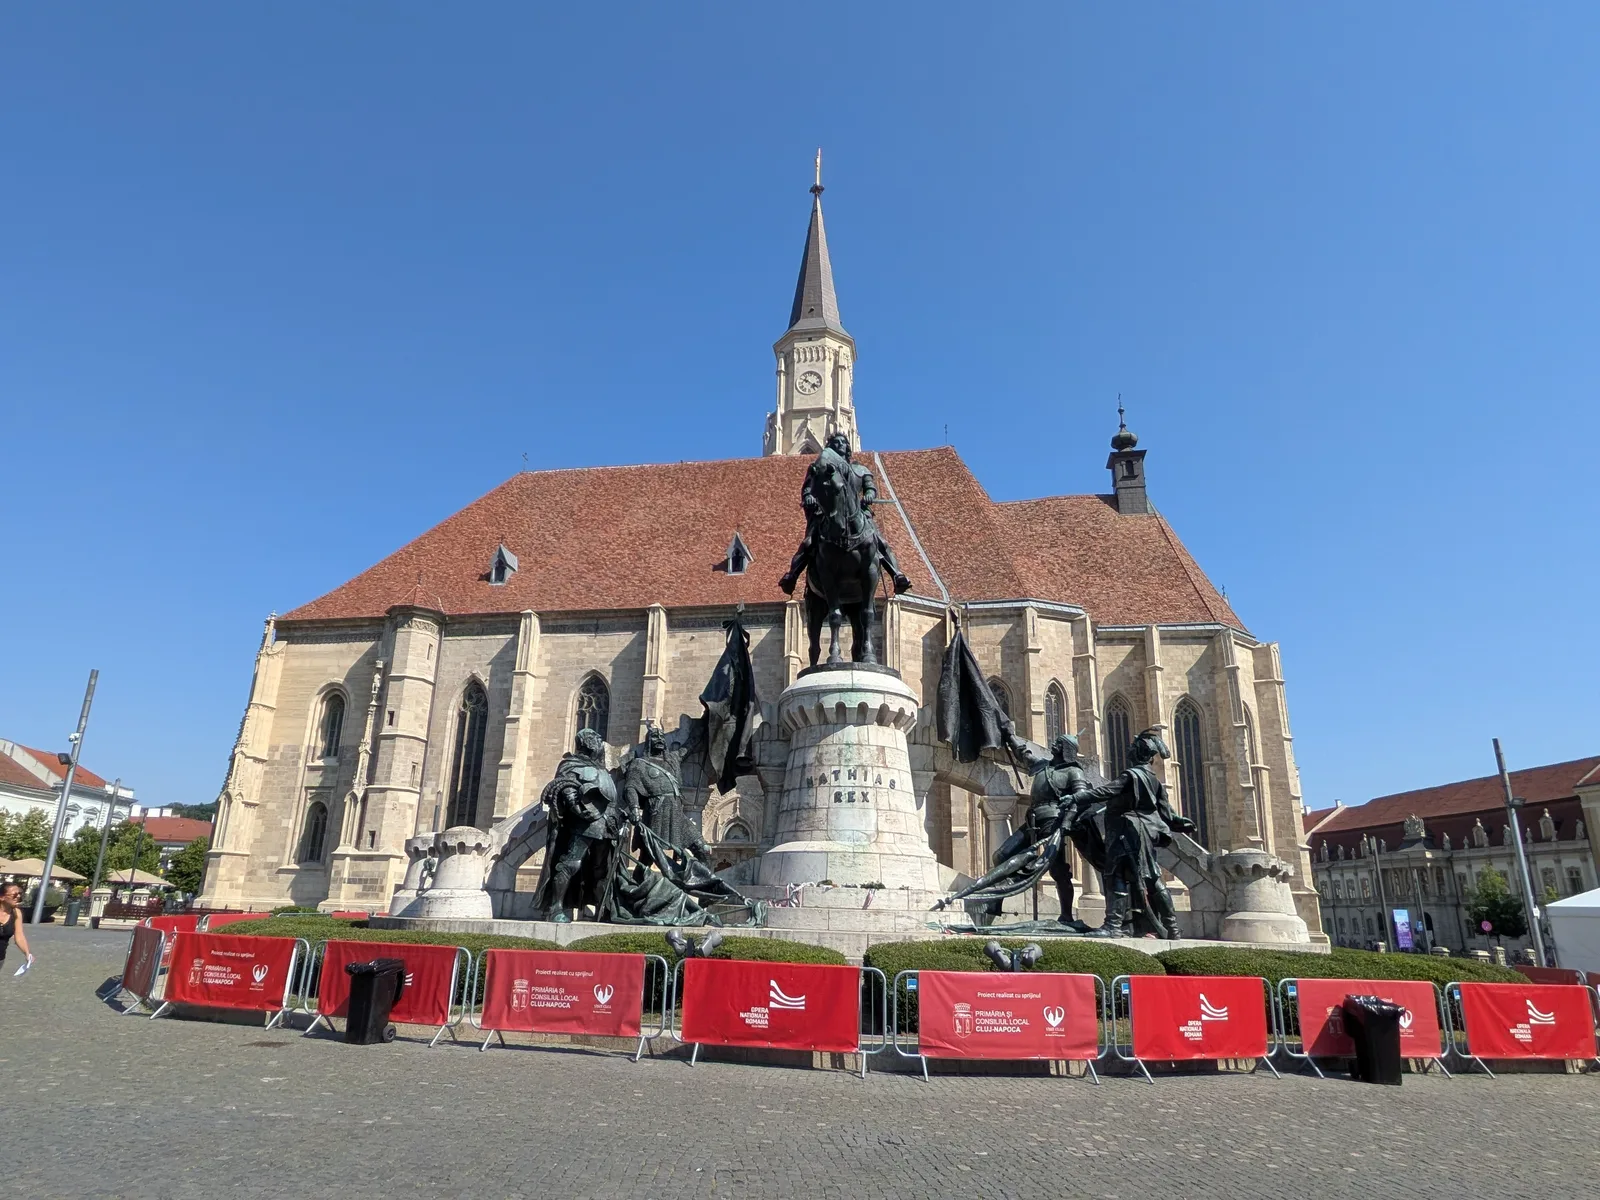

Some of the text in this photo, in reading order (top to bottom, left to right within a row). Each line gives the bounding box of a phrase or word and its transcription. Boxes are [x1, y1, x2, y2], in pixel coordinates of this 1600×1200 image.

[806, 769, 896, 789] MATHIAS
[834, 791, 869, 803] REX
[1021, 992, 1041, 1000] sprijinul
[975, 1009, 1006, 1017] PRIMĂRIA
